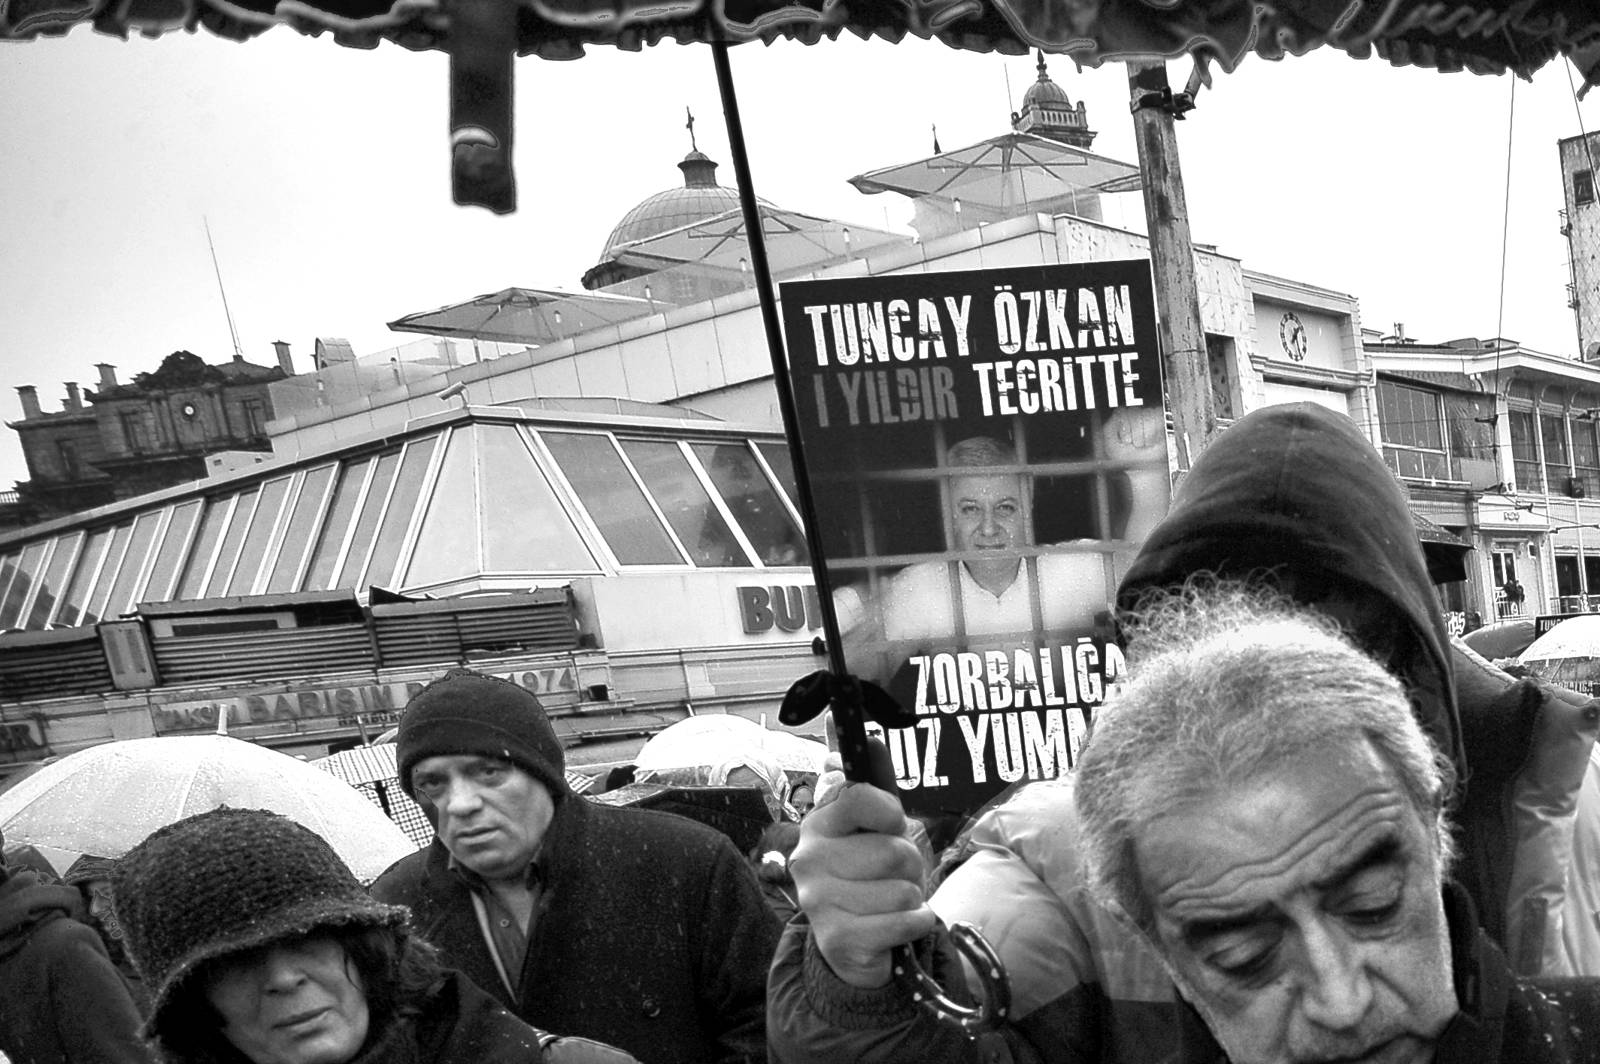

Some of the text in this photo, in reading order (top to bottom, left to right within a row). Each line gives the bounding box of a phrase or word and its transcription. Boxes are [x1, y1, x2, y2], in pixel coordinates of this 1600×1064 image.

[804, 285, 1135, 366] TUNCAY ÖZKAN
[837, 365, 959, 427] YILDIR
